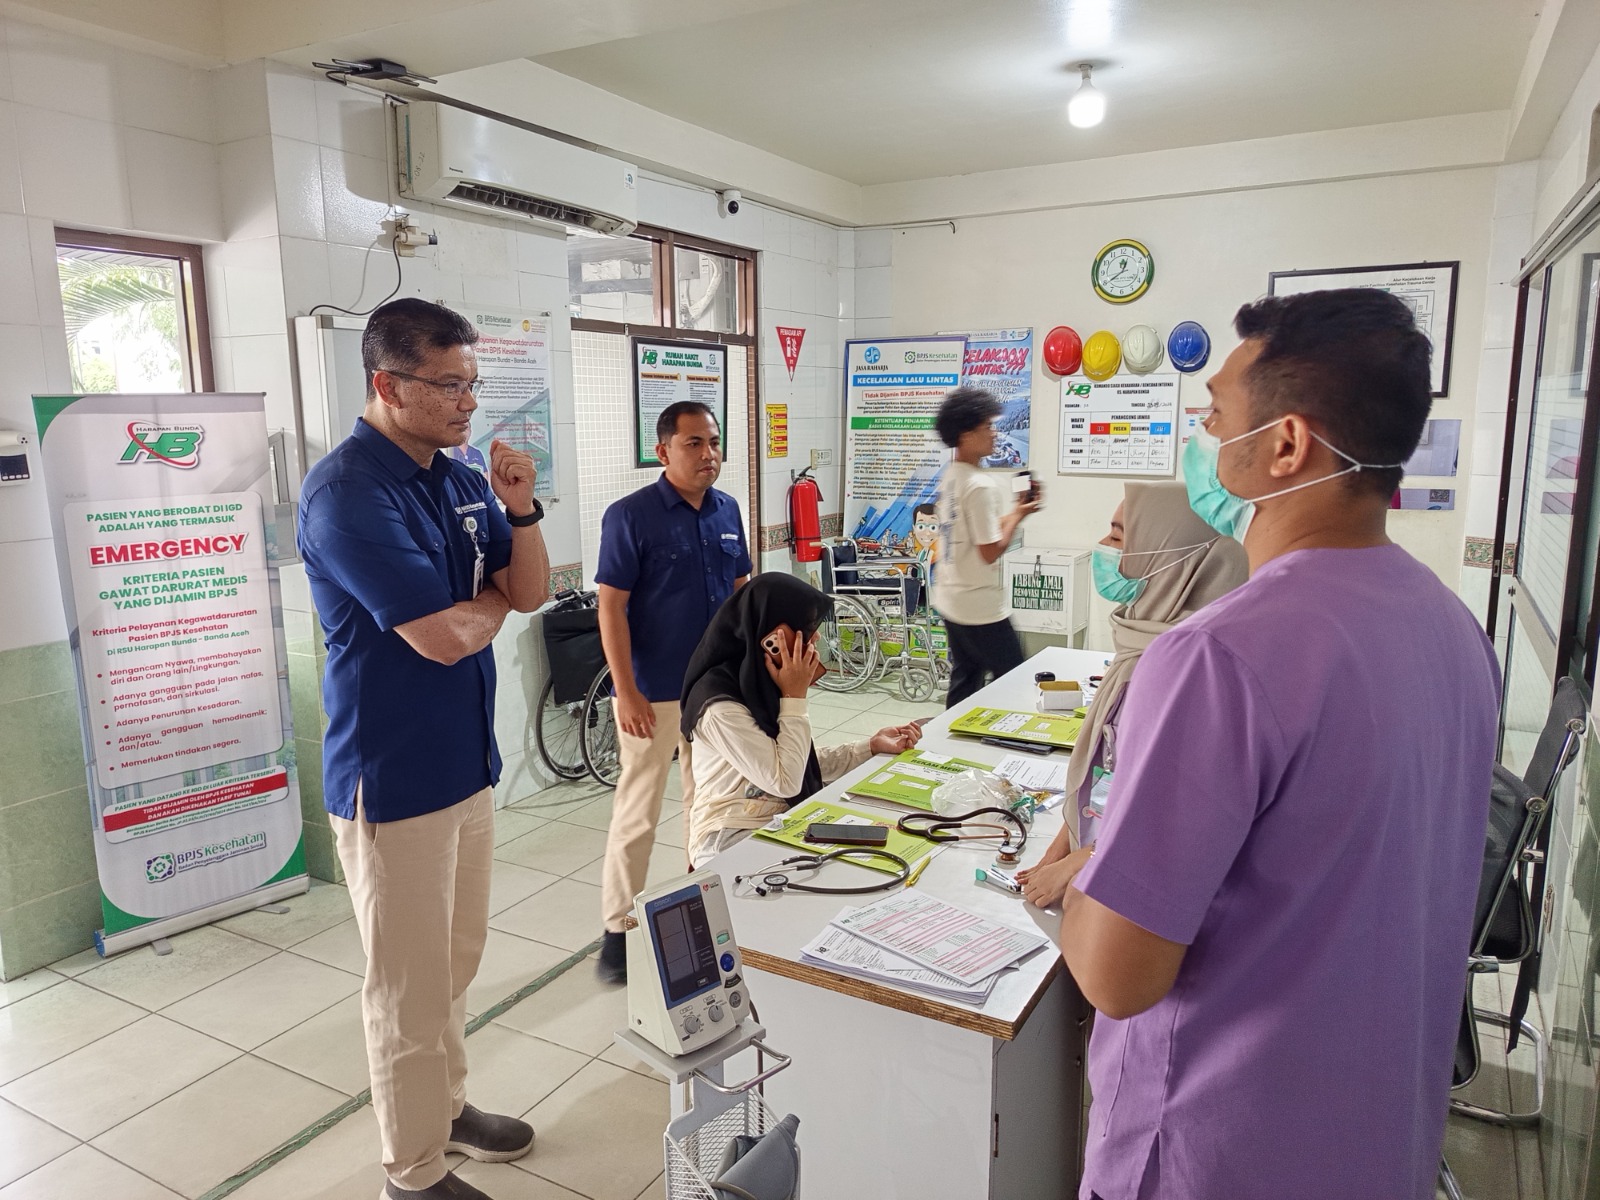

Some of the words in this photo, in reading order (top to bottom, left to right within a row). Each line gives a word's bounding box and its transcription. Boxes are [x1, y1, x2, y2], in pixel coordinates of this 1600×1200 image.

[120, 432, 201, 461] HB
[87, 512, 127, 521] PASIEN
[129, 510, 161, 519] YANG
[163, 506, 210, 517] BEROBAT
[98, 523, 144, 533] ADALAH
[147, 520, 178, 528] YANG
[180, 515, 235, 526] TERMASUK
[90, 534, 246, 565] EMERGENCY
[99, 586, 150, 600] GAWAT
[152, 581, 210, 594] DARURAT
[213, 575, 248, 587] MEDIS
[123, 572, 180, 585] KRITERIA
[183, 567, 224, 579] PASIEN
[1015, 574, 1041, 588] TABUNG
[1043, 576, 1062, 589] AMAL
[114, 599, 151, 610] YANG
[154, 592, 206, 605] DIJAMIN
[209, 588, 237, 598] BPJS
[92, 626, 127, 637] Kriteria
[129, 620, 176, 632] Pelayanan
[178, 609, 257, 626] Kegawatdaruratan
[129, 634, 158, 642] Pasien
[160, 629, 181, 638] BPJS
[183, 623, 228, 635] Kesehatan
[117, 646, 132, 654] RSU
[135, 641, 170, 653] Harapan
[171, 637, 197, 646] Bunda
[204, 633, 229, 642] Banda
[110, 663, 163, 677] Mengancam
[165, 658, 196, 669] Nyawa,
[198, 647, 261, 663] membahayakan
[111, 677, 125, 685] diri
[127, 674, 143, 683] dan
[146, 670, 171, 680] Orang
[173, 660, 240, 674] lain/Lingkungan.
[113, 691, 147, 702] Adanya
[150, 683, 192, 697] gangguan
[195, 679, 215, 690] pada
[218, 676, 238, 685] jalan
[114, 696, 165, 712] pernafasan,
[167, 692, 183, 700] dan
[185, 687, 220, 698] sirkulasi.
[116, 715, 149, 728] Adanya
[152, 707, 196, 720] Penurunan
[198, 698, 242, 711] Kesadaran.
[118, 732, 152, 744] Adanya
[161, 722, 204, 736] gangguan
[119, 739, 162, 752] dan/atau.
[121, 752, 173, 768] Memerlukan
[175, 744, 211, 757] tindakan
[213, 738, 241, 750] segera.
[911, 759, 938, 768] REKAM
[115, 802, 137, 812] PASIEN
[157, 791, 182, 801] DATANG
[225, 776, 249, 784] KRITERIA
[251, 769, 276, 778] TERSEBUT
[163, 799, 188, 809] DIJAMIN
[220, 782, 254, 794] KESEHATAN
[163, 808, 180, 816] AKAN
[181, 798, 217, 812] DIKENAKAN
[177, 849, 203, 864] BPJS
[204, 833, 263, 856] Kesehatan
